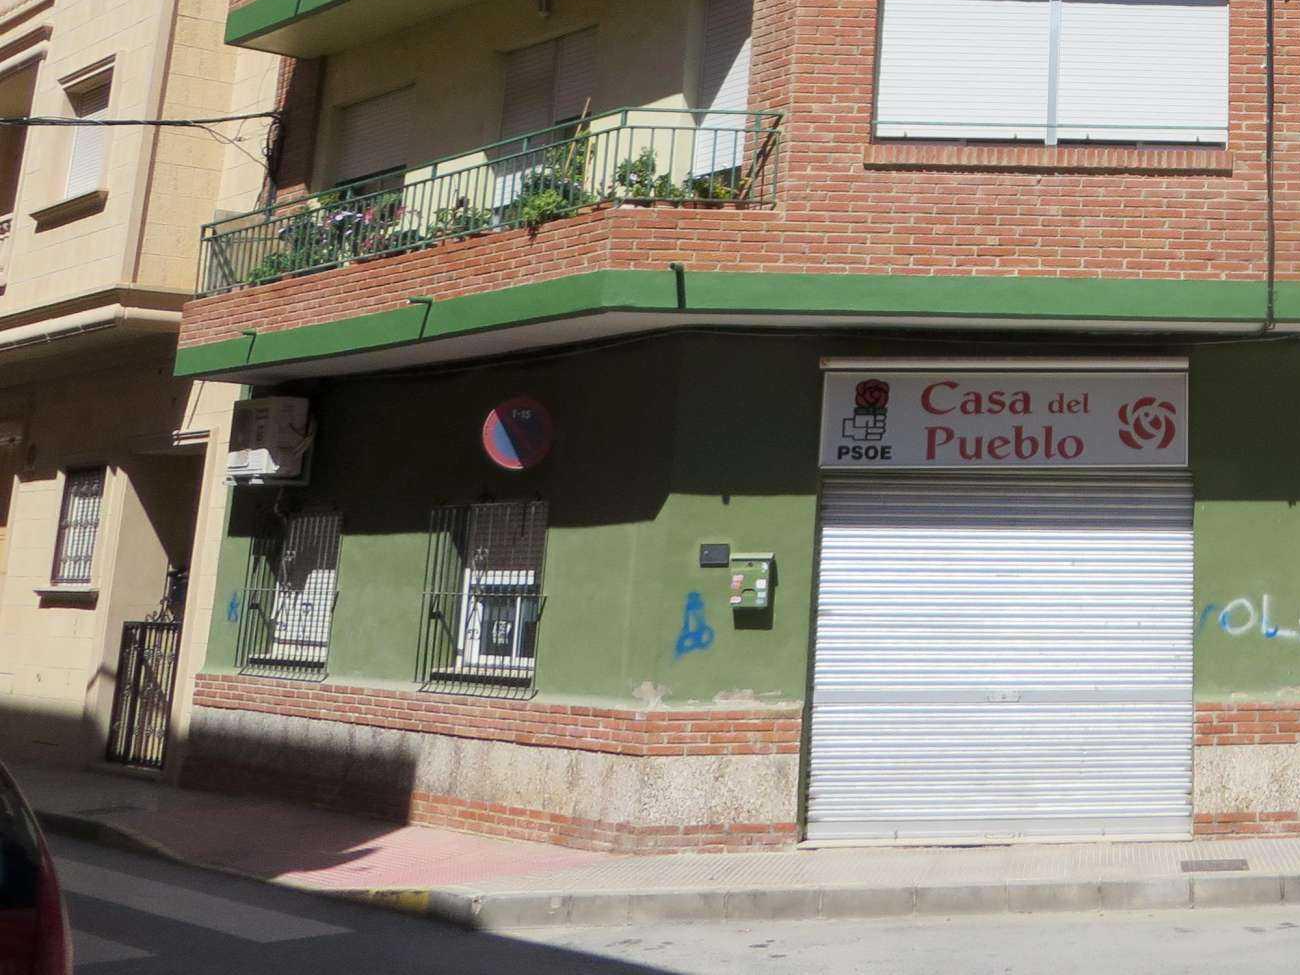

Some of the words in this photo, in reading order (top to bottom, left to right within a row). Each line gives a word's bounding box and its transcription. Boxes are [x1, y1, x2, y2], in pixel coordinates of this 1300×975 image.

[920, 381, 1032, 416] Casa
[1048, 393, 1090, 415] del
[837, 445, 892, 460] PSOE
[924, 426, 1084, 461] Pueblo
